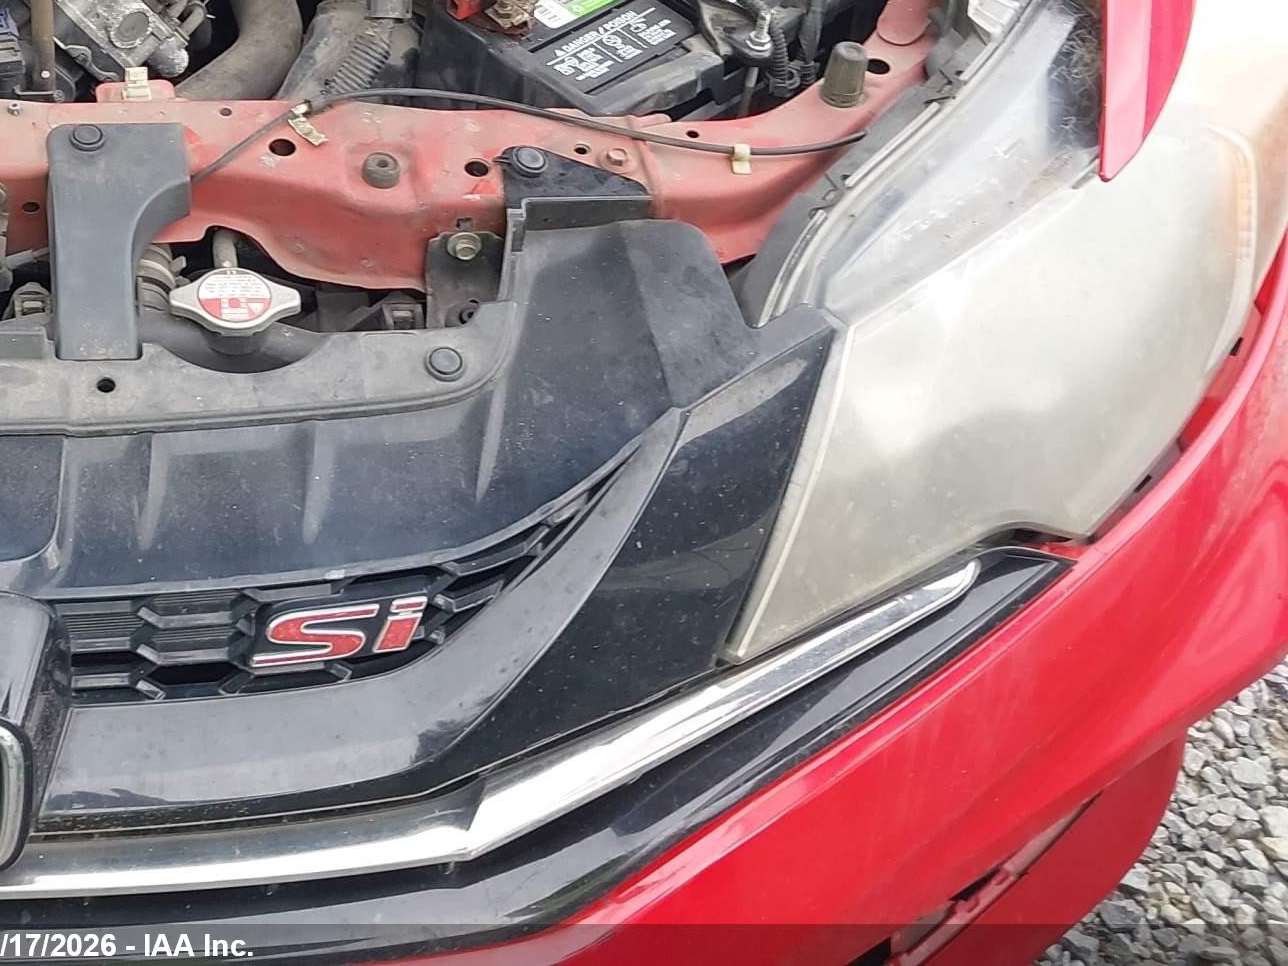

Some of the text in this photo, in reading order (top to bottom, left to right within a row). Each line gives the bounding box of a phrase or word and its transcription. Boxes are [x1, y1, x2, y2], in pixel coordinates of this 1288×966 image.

[561, 31, 600, 53] DANGER
[602, 10, 637, 31] POISON
[250, 595, 428, 667] Si
